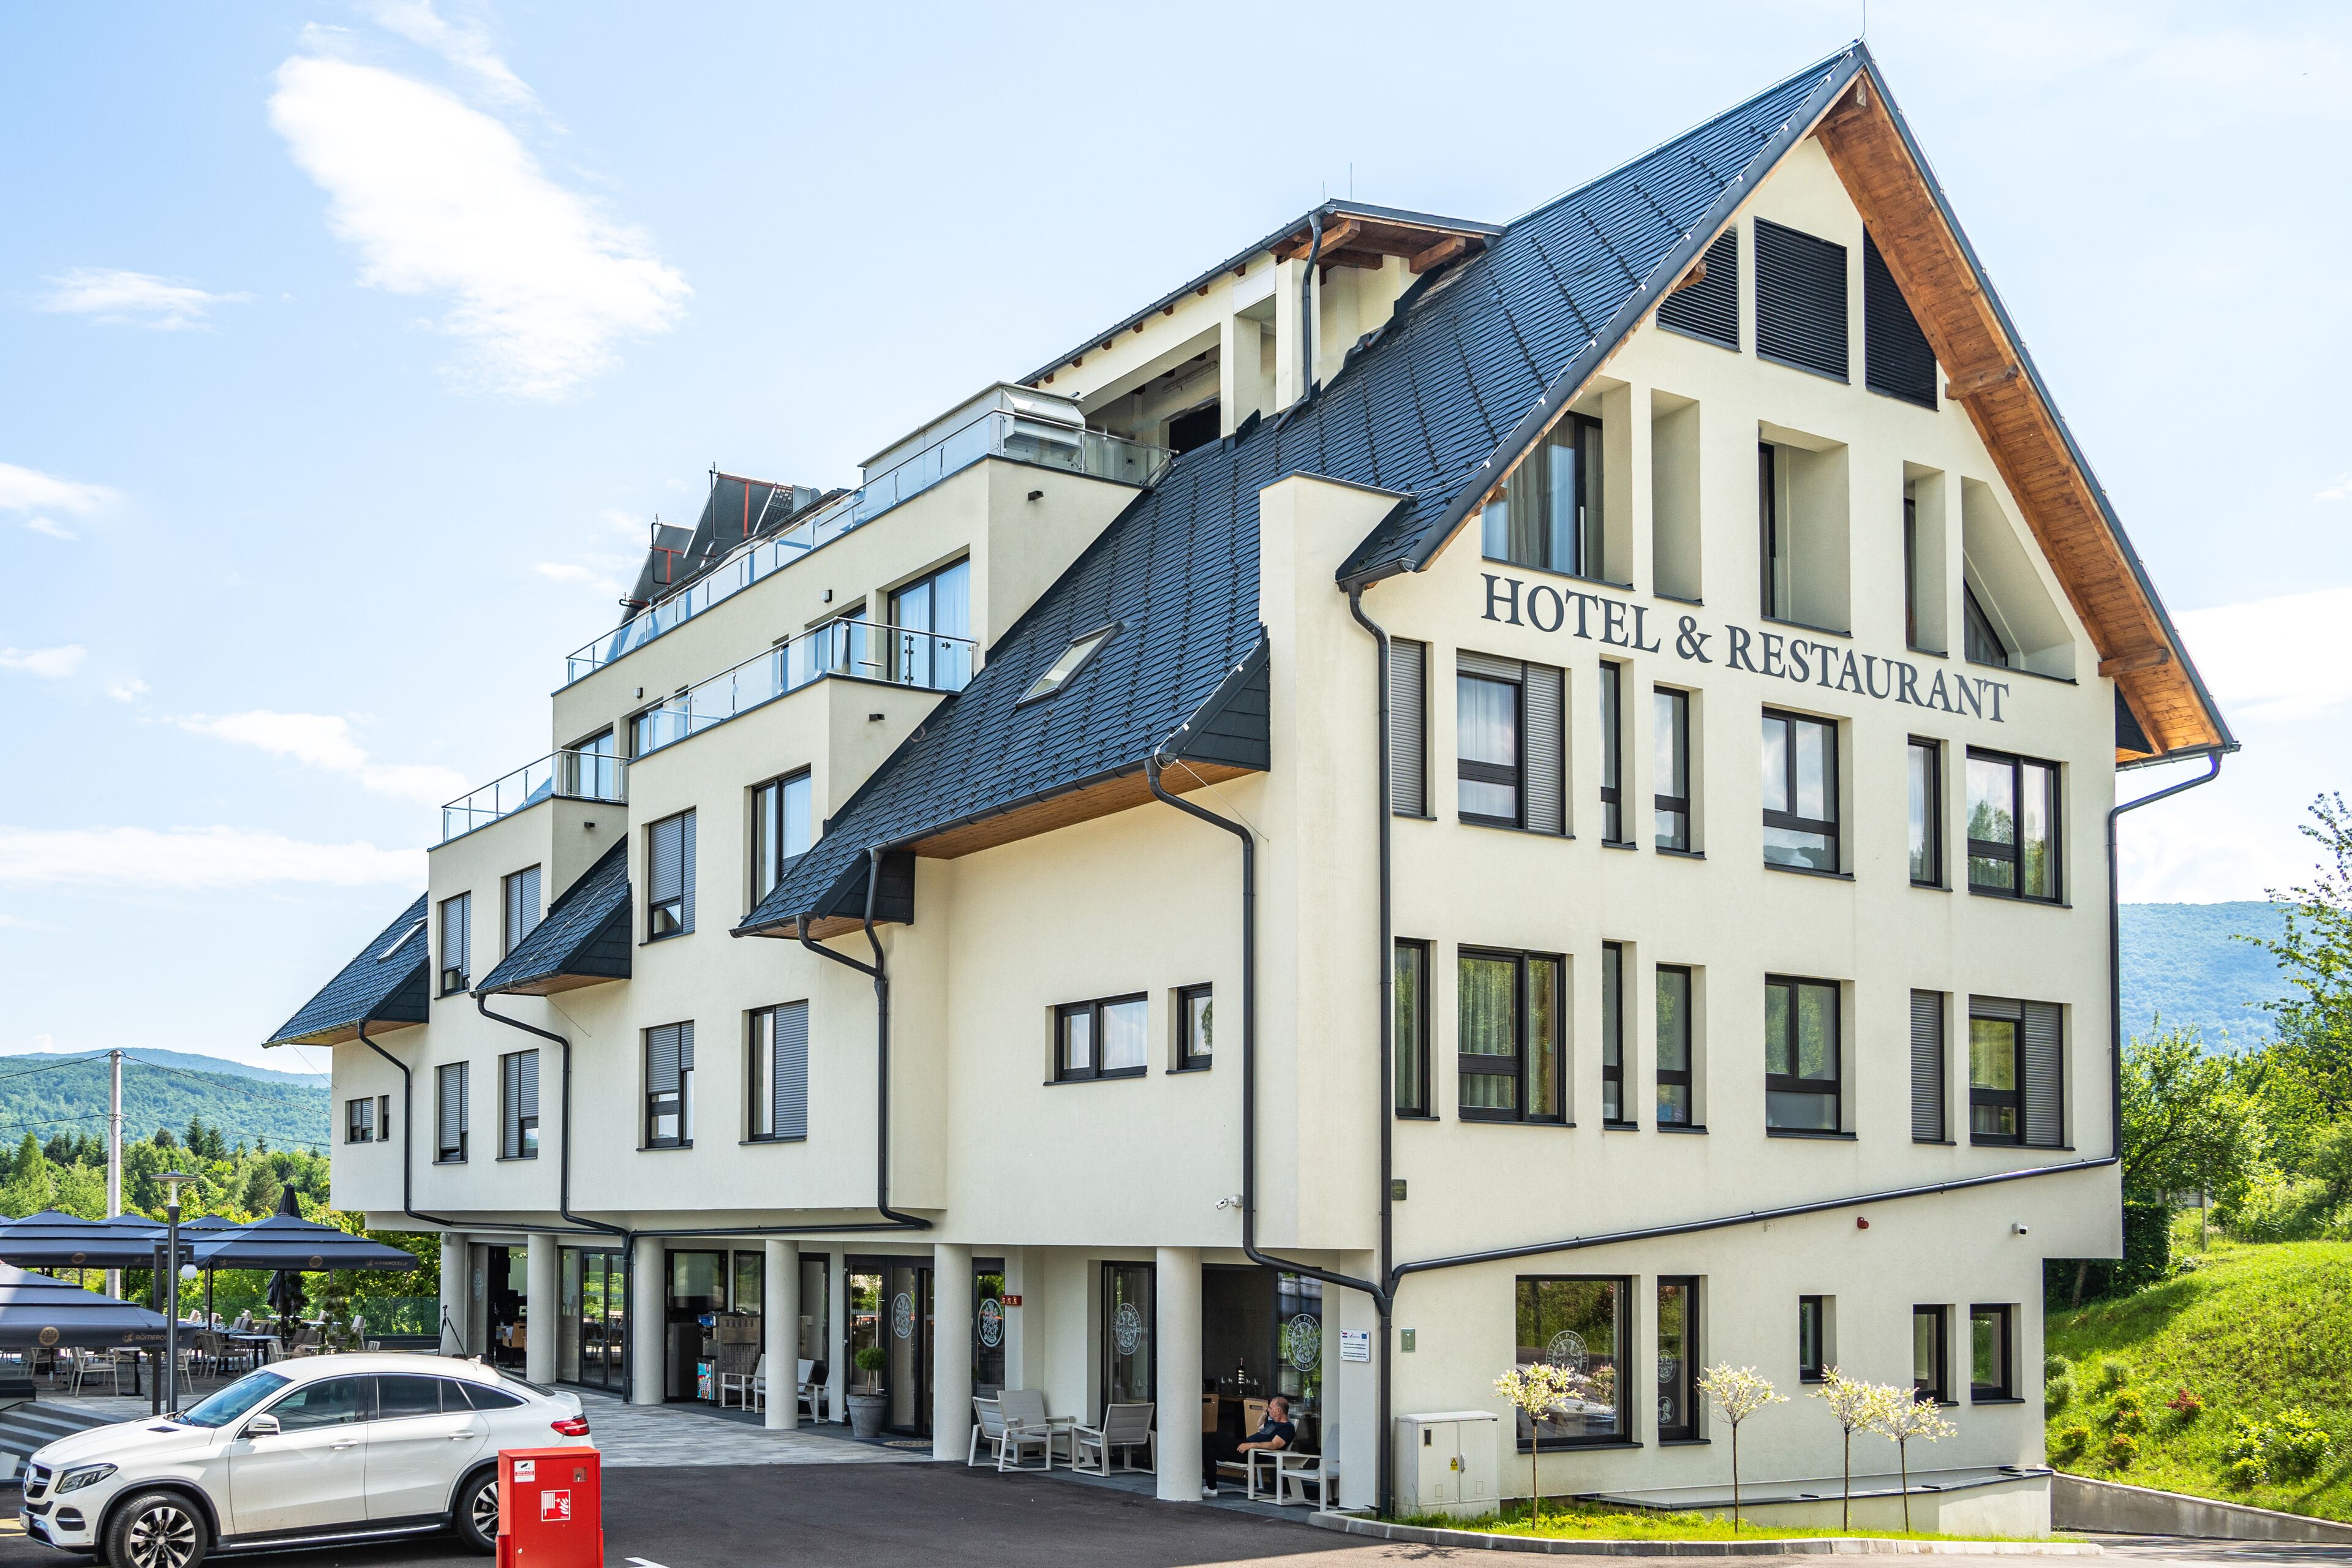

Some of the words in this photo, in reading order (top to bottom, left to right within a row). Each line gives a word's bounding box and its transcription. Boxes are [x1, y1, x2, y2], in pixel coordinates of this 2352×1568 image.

[1480, 572, 1662, 654] HOTEL
[1675, 615, 1713, 664] &
[1724, 624, 2010, 723] RESTAURANT
[1548, 1335, 1563, 1363] HOTEL
[1566, 1333, 1588, 1363] PALCICH
